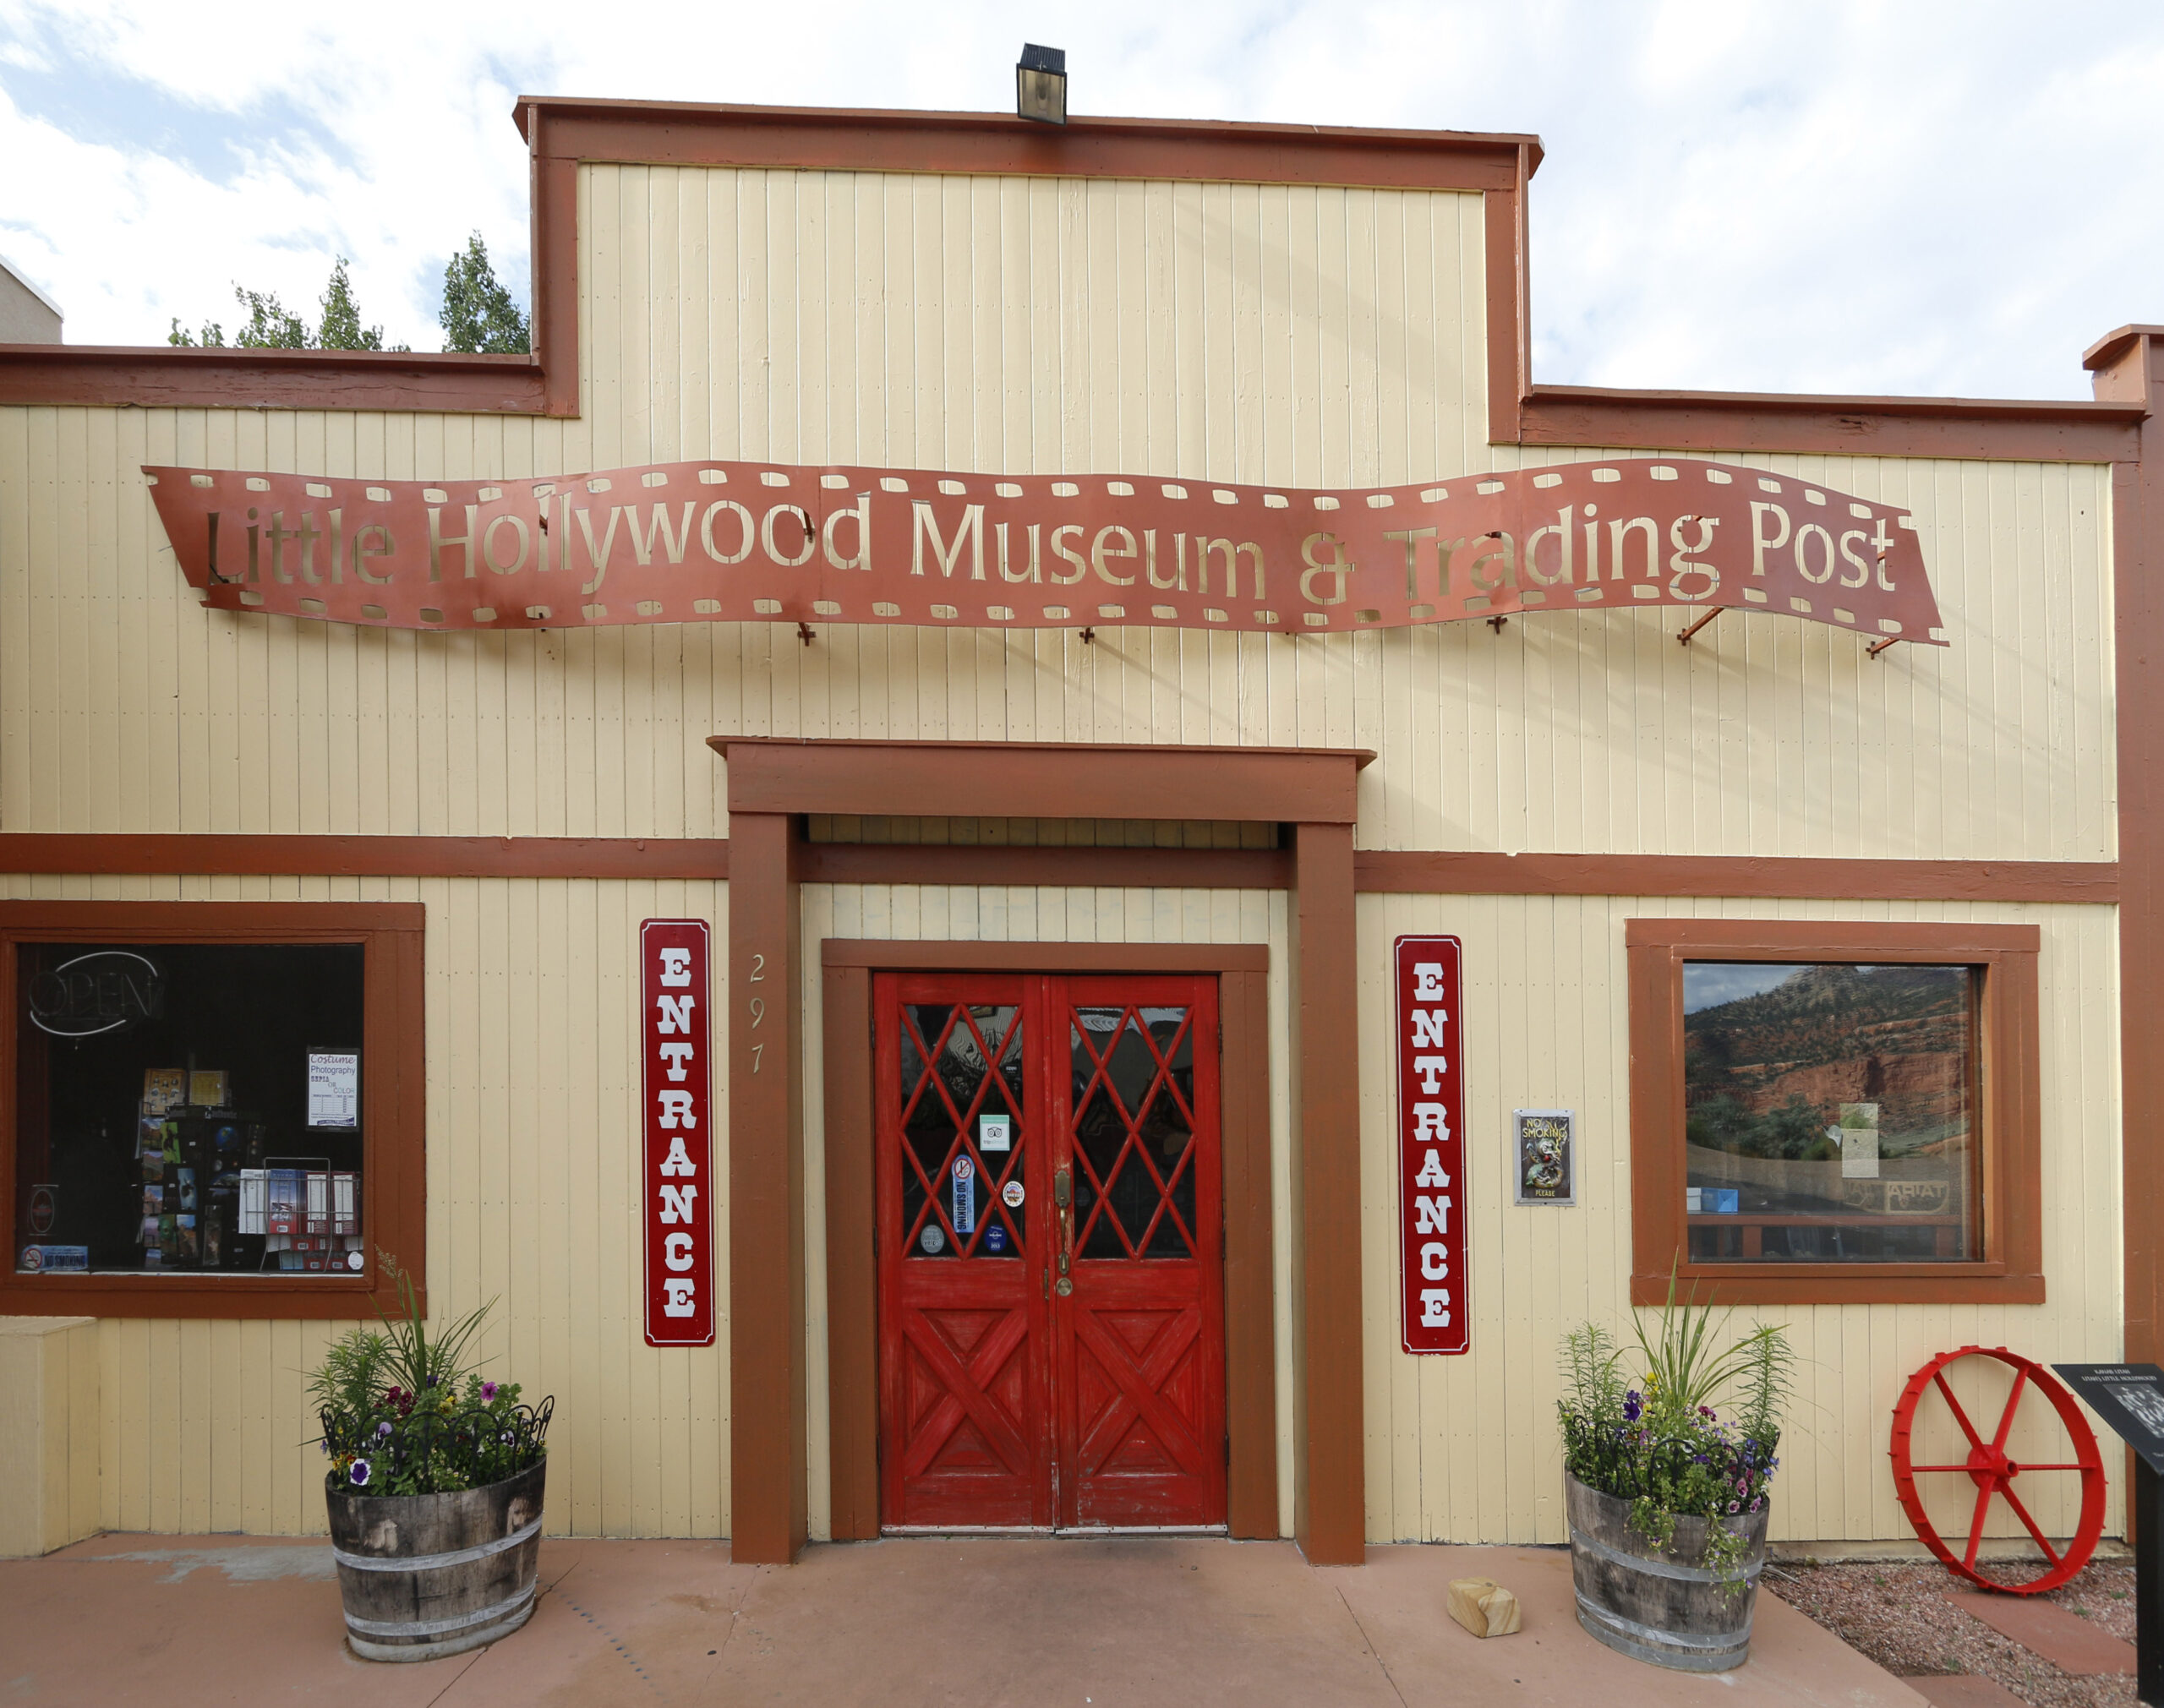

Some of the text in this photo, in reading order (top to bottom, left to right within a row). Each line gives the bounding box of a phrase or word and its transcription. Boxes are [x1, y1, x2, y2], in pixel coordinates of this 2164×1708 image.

[205, 489, 1897, 605] Little Hollywood Museum & Trading Post
[29, 971, 152, 1017] OPEN
[750, 954, 765, 1074] 297
[310, 1054, 355, 1064] Costume
[310, 1065, 356, 1075] Photography
[656, 947, 698, 1318] ENTRANCE
[1522, 1127, 1567, 1138] SMOKING
[1527, 1118, 1541, 1127] NO
[1411, 963, 1452, 1328] ENTRANCE
[1889, 1183, 1944, 1198] ARIAT
[956, 1181, 967, 1231] NO SMOKING
[44, 1254, 86, 1267] NO SMOKING
